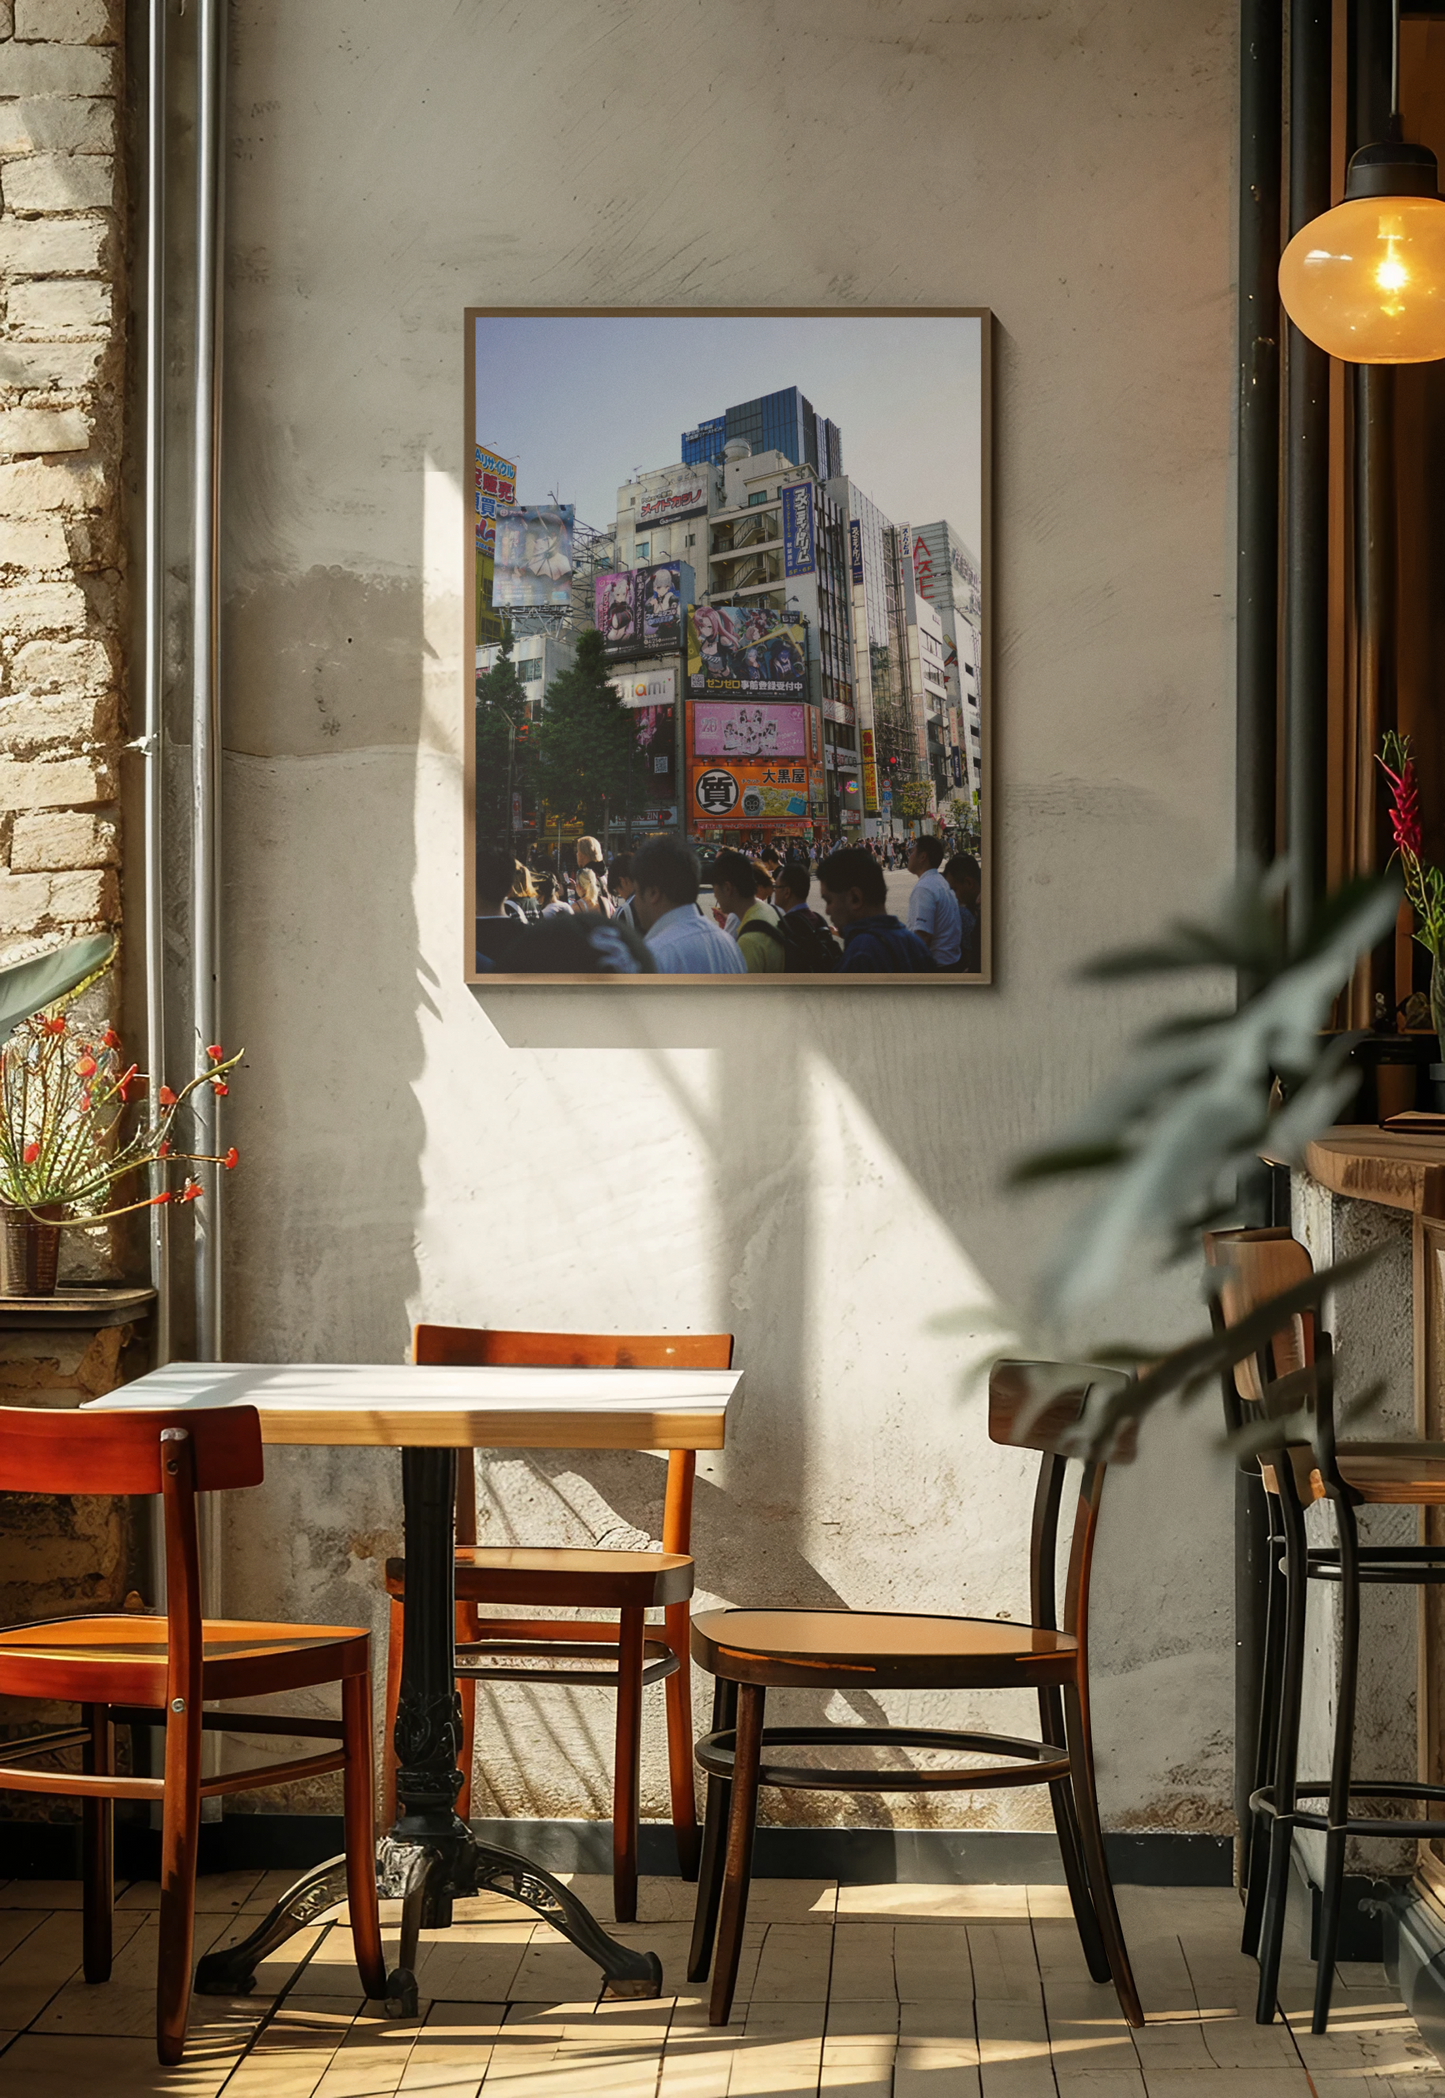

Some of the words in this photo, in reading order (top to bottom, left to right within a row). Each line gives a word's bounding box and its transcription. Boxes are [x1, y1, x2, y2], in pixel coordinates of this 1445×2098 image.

[641, 489, 702, 517] メイドカジノ
[762, 768, 806, 784] 大黒屋
[701, 775, 733, 809] 質
